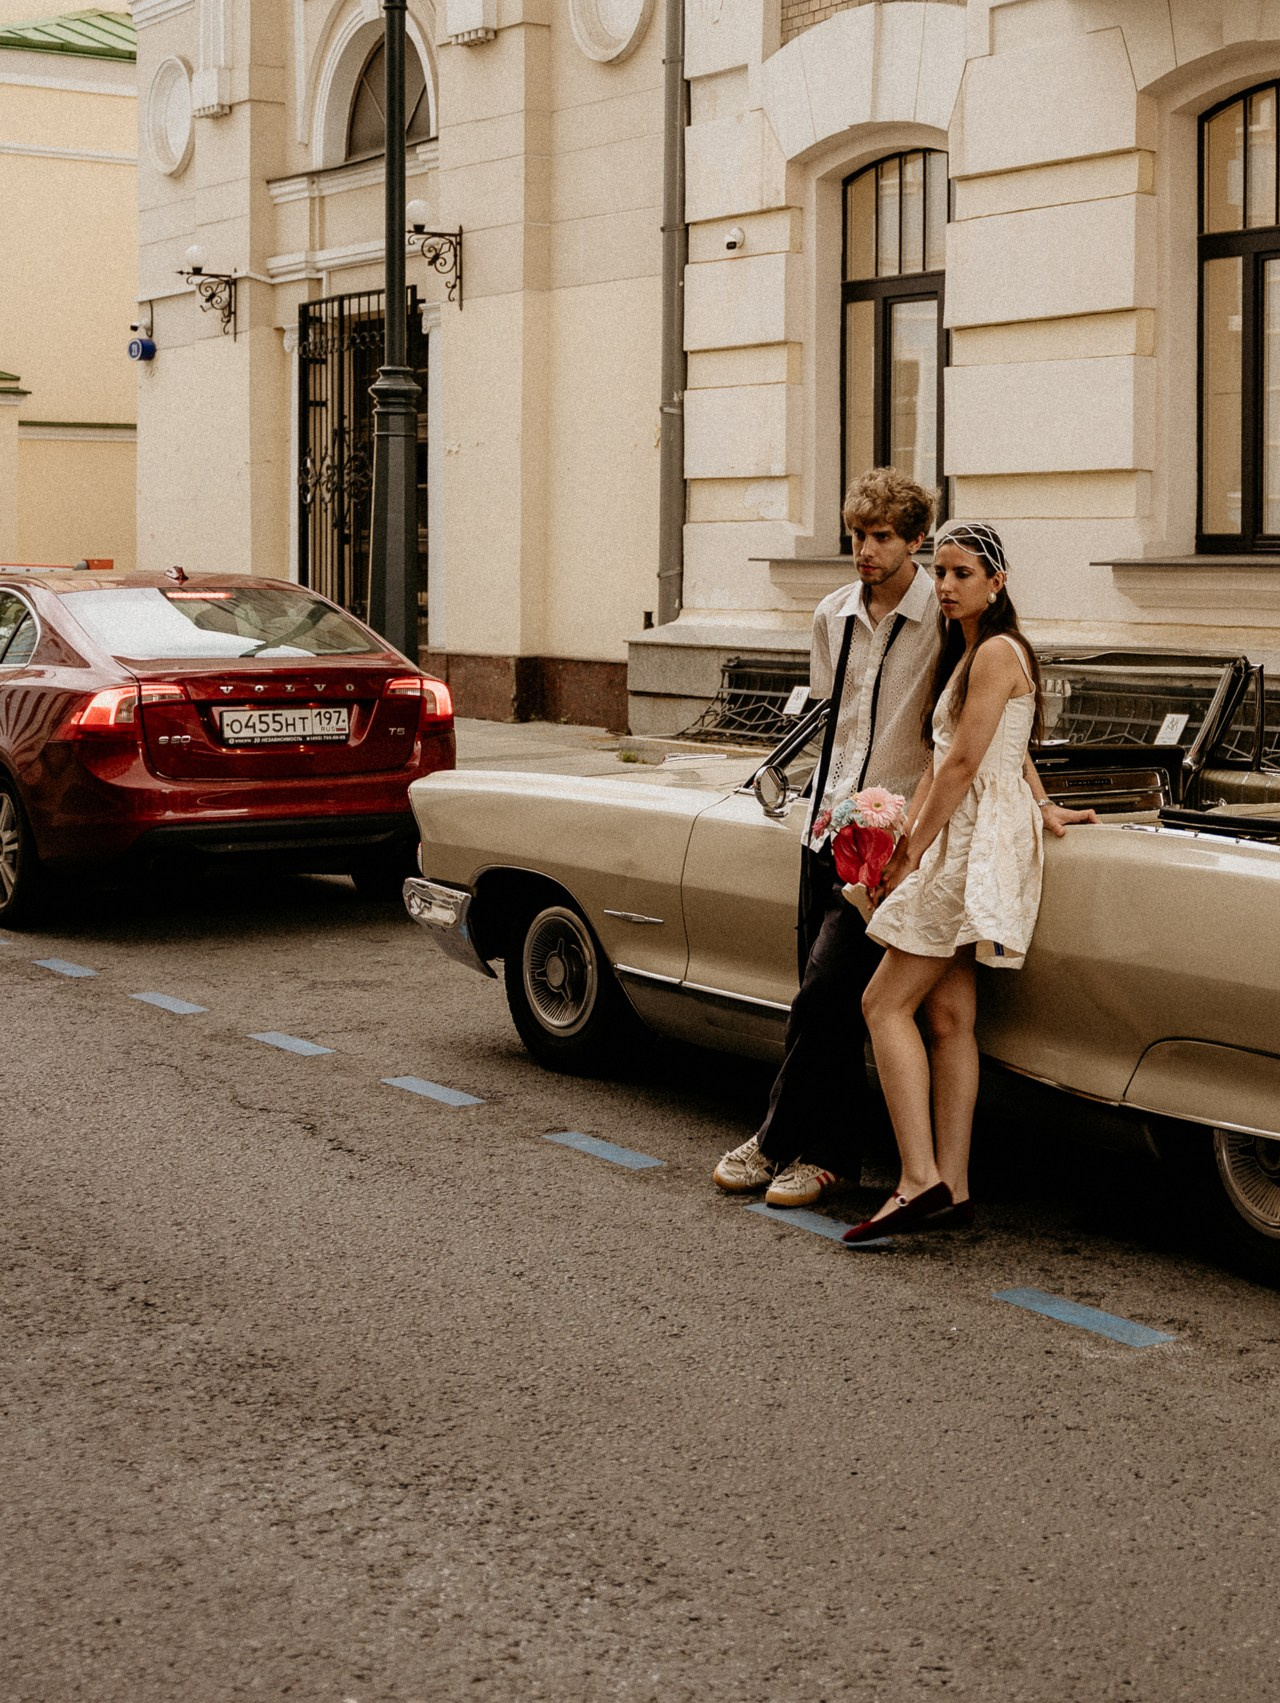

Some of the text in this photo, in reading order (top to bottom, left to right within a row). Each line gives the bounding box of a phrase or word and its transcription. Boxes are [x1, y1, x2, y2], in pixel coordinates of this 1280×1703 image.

[220, 684, 355, 694] VOLVO
[314, 711, 342, 726] 197
[388, 727, 406, 736] T5
